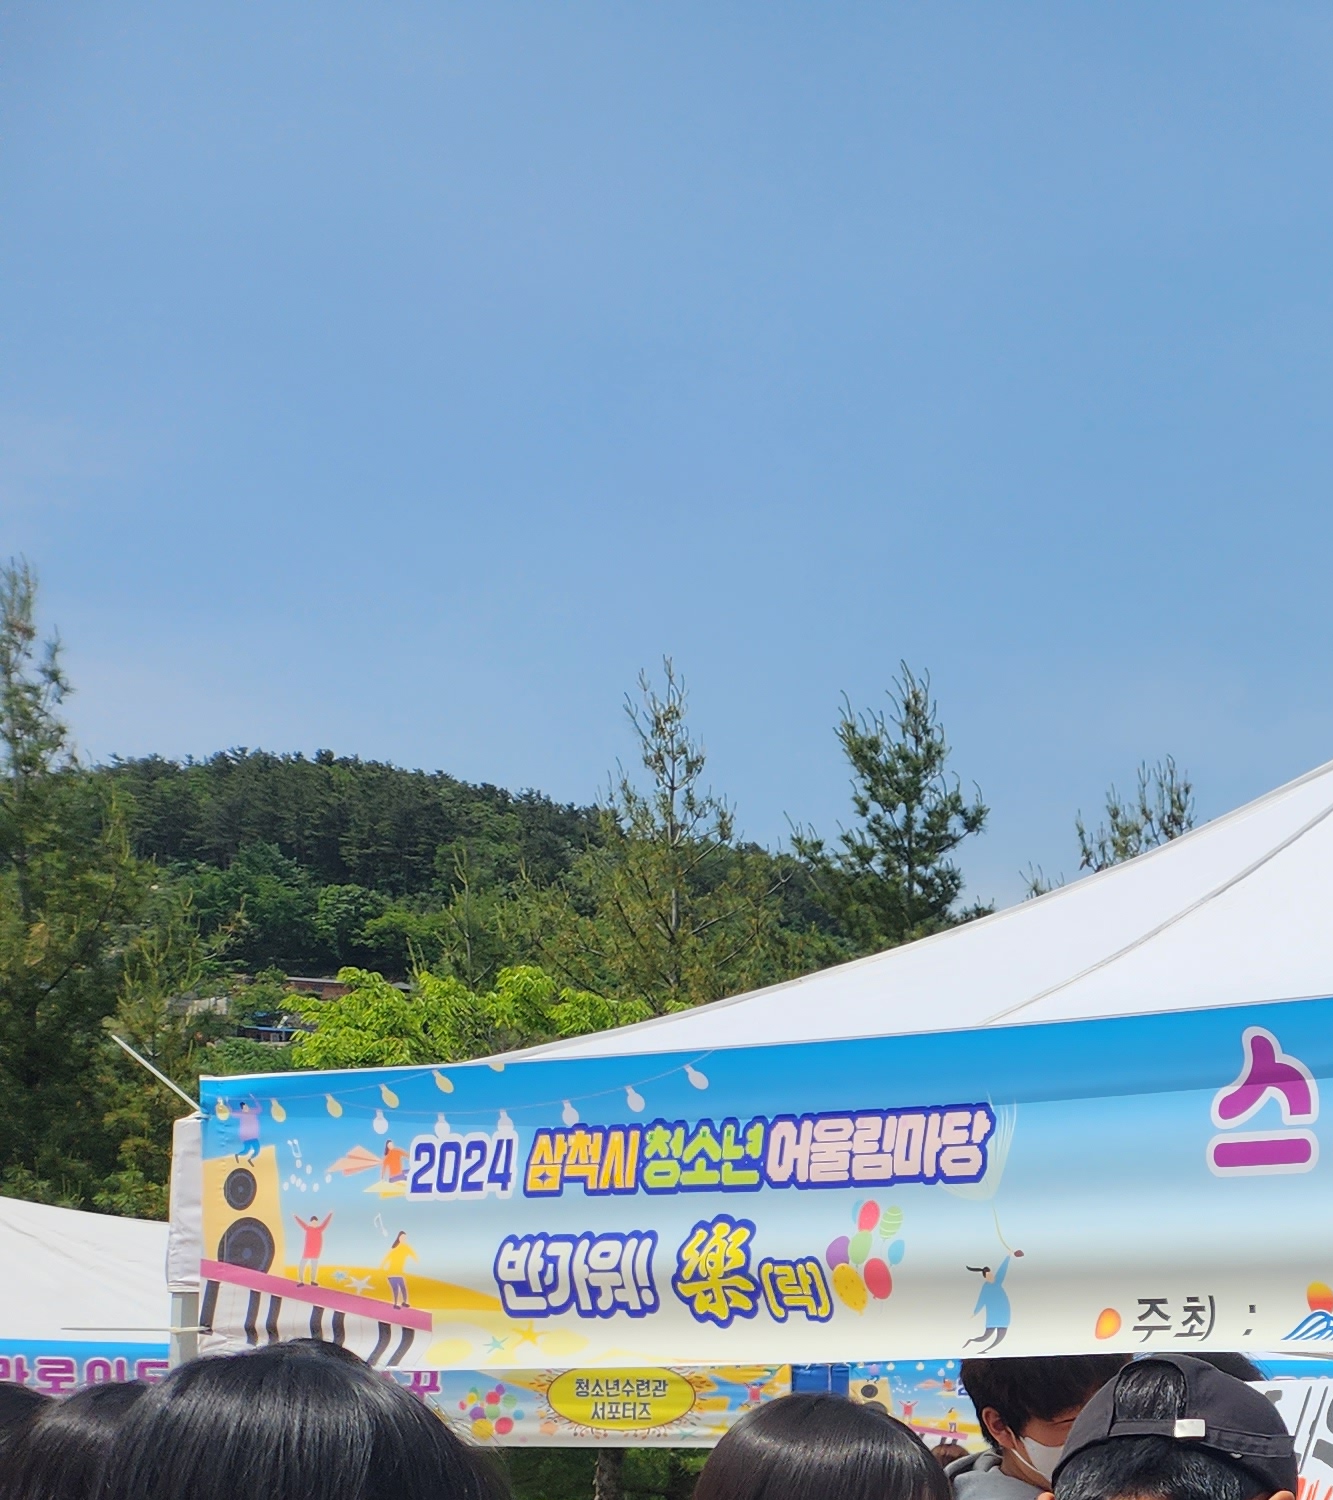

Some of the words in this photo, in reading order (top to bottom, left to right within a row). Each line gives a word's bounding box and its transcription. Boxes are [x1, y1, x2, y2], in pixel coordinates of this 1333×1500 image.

[409, 1141, 514, 1193] 2024
[526, 1127, 638, 1194] 삼척시
[643, 1115, 766, 1188] 청소년
[768, 1104, 992, 1187] 어울림마당
[498, 1233, 655, 1316] 반가워!
[1131, 1295, 1216, 1342] 주최
[574, 1378, 669, 1398] 청소년수련관
[590, 1401, 652, 1421] 서포터즈
